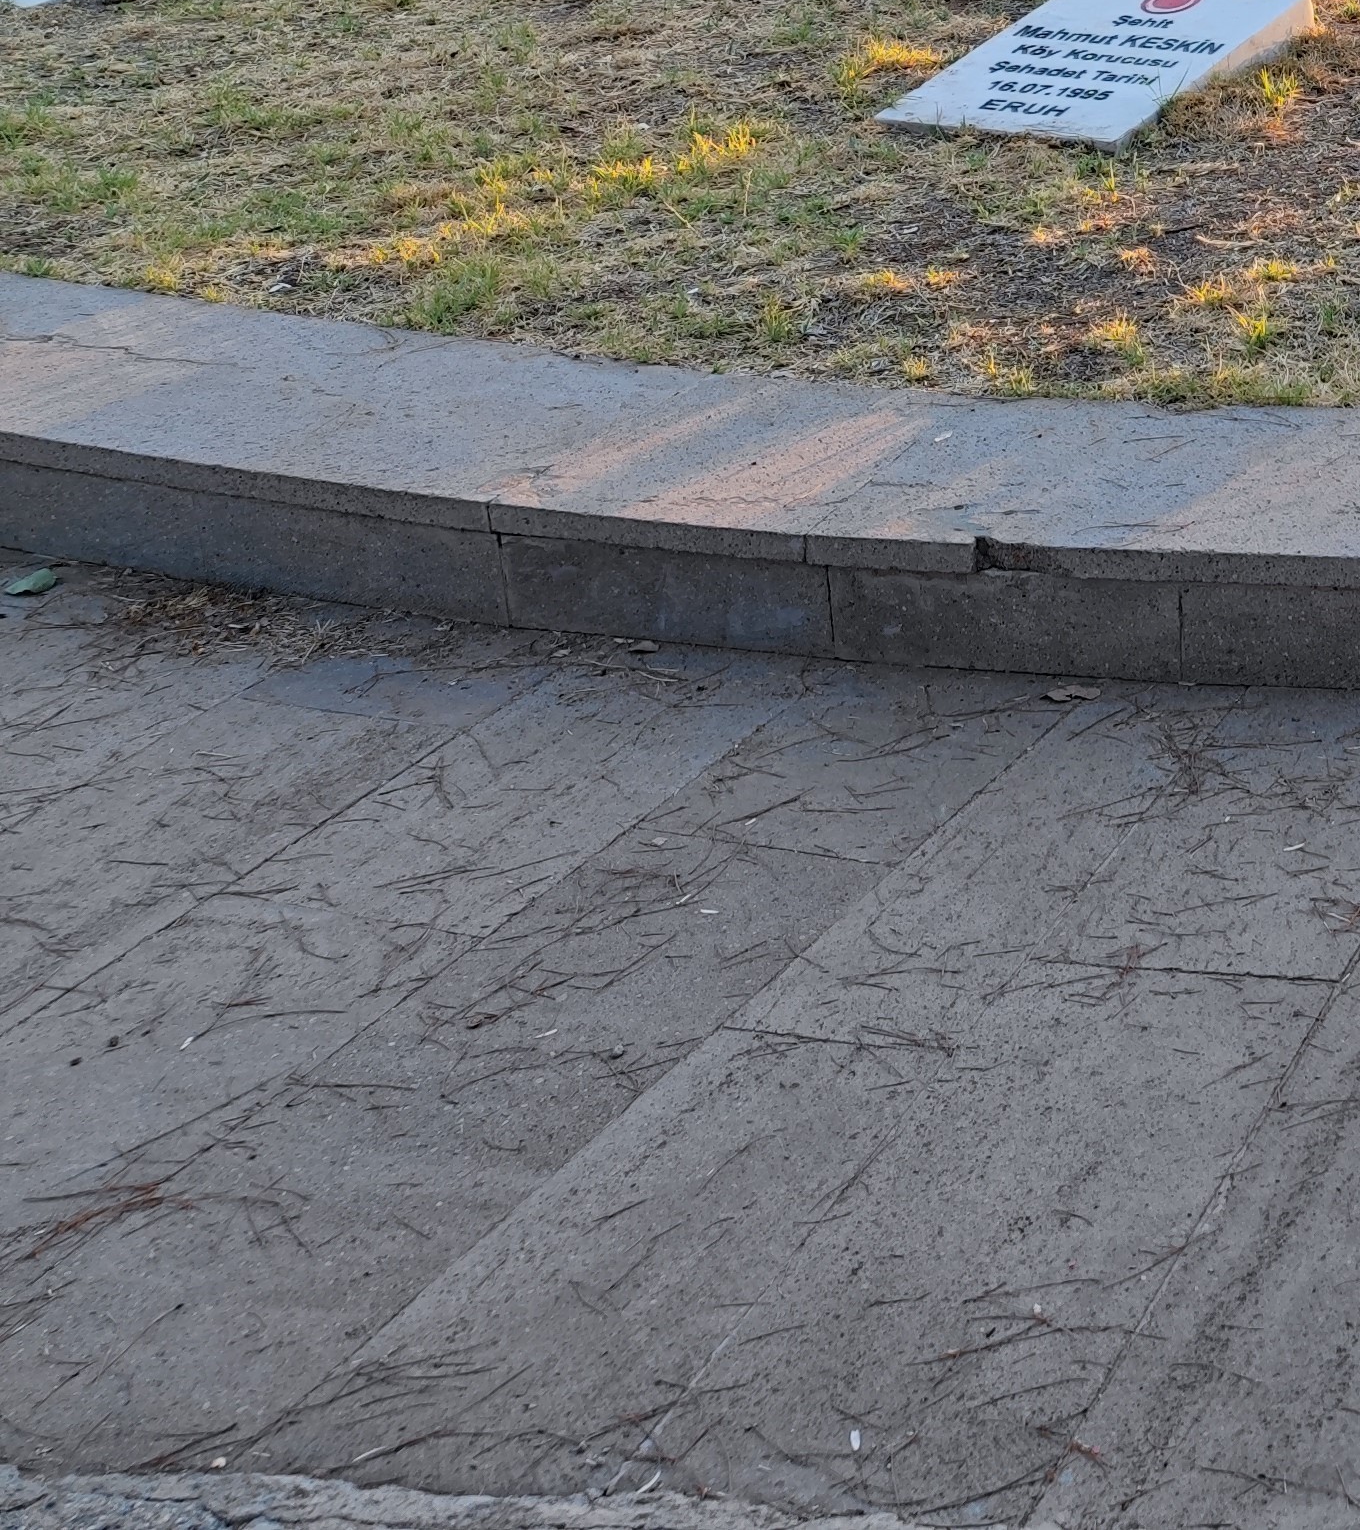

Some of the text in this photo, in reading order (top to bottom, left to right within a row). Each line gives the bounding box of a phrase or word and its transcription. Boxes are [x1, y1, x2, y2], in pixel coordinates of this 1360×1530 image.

[1111, 14, 1174, 29] Şehit
[1013, 24, 1225, 55] Mahmut KESKİN
[1011, 44, 1179, 69] Köy Korucusu
[988, 60, 1160, 86] Şehadet Tarihi
[987, 79, 1115, 101] 16.07.1995
[978, 98, 1071, 117] ERUH
